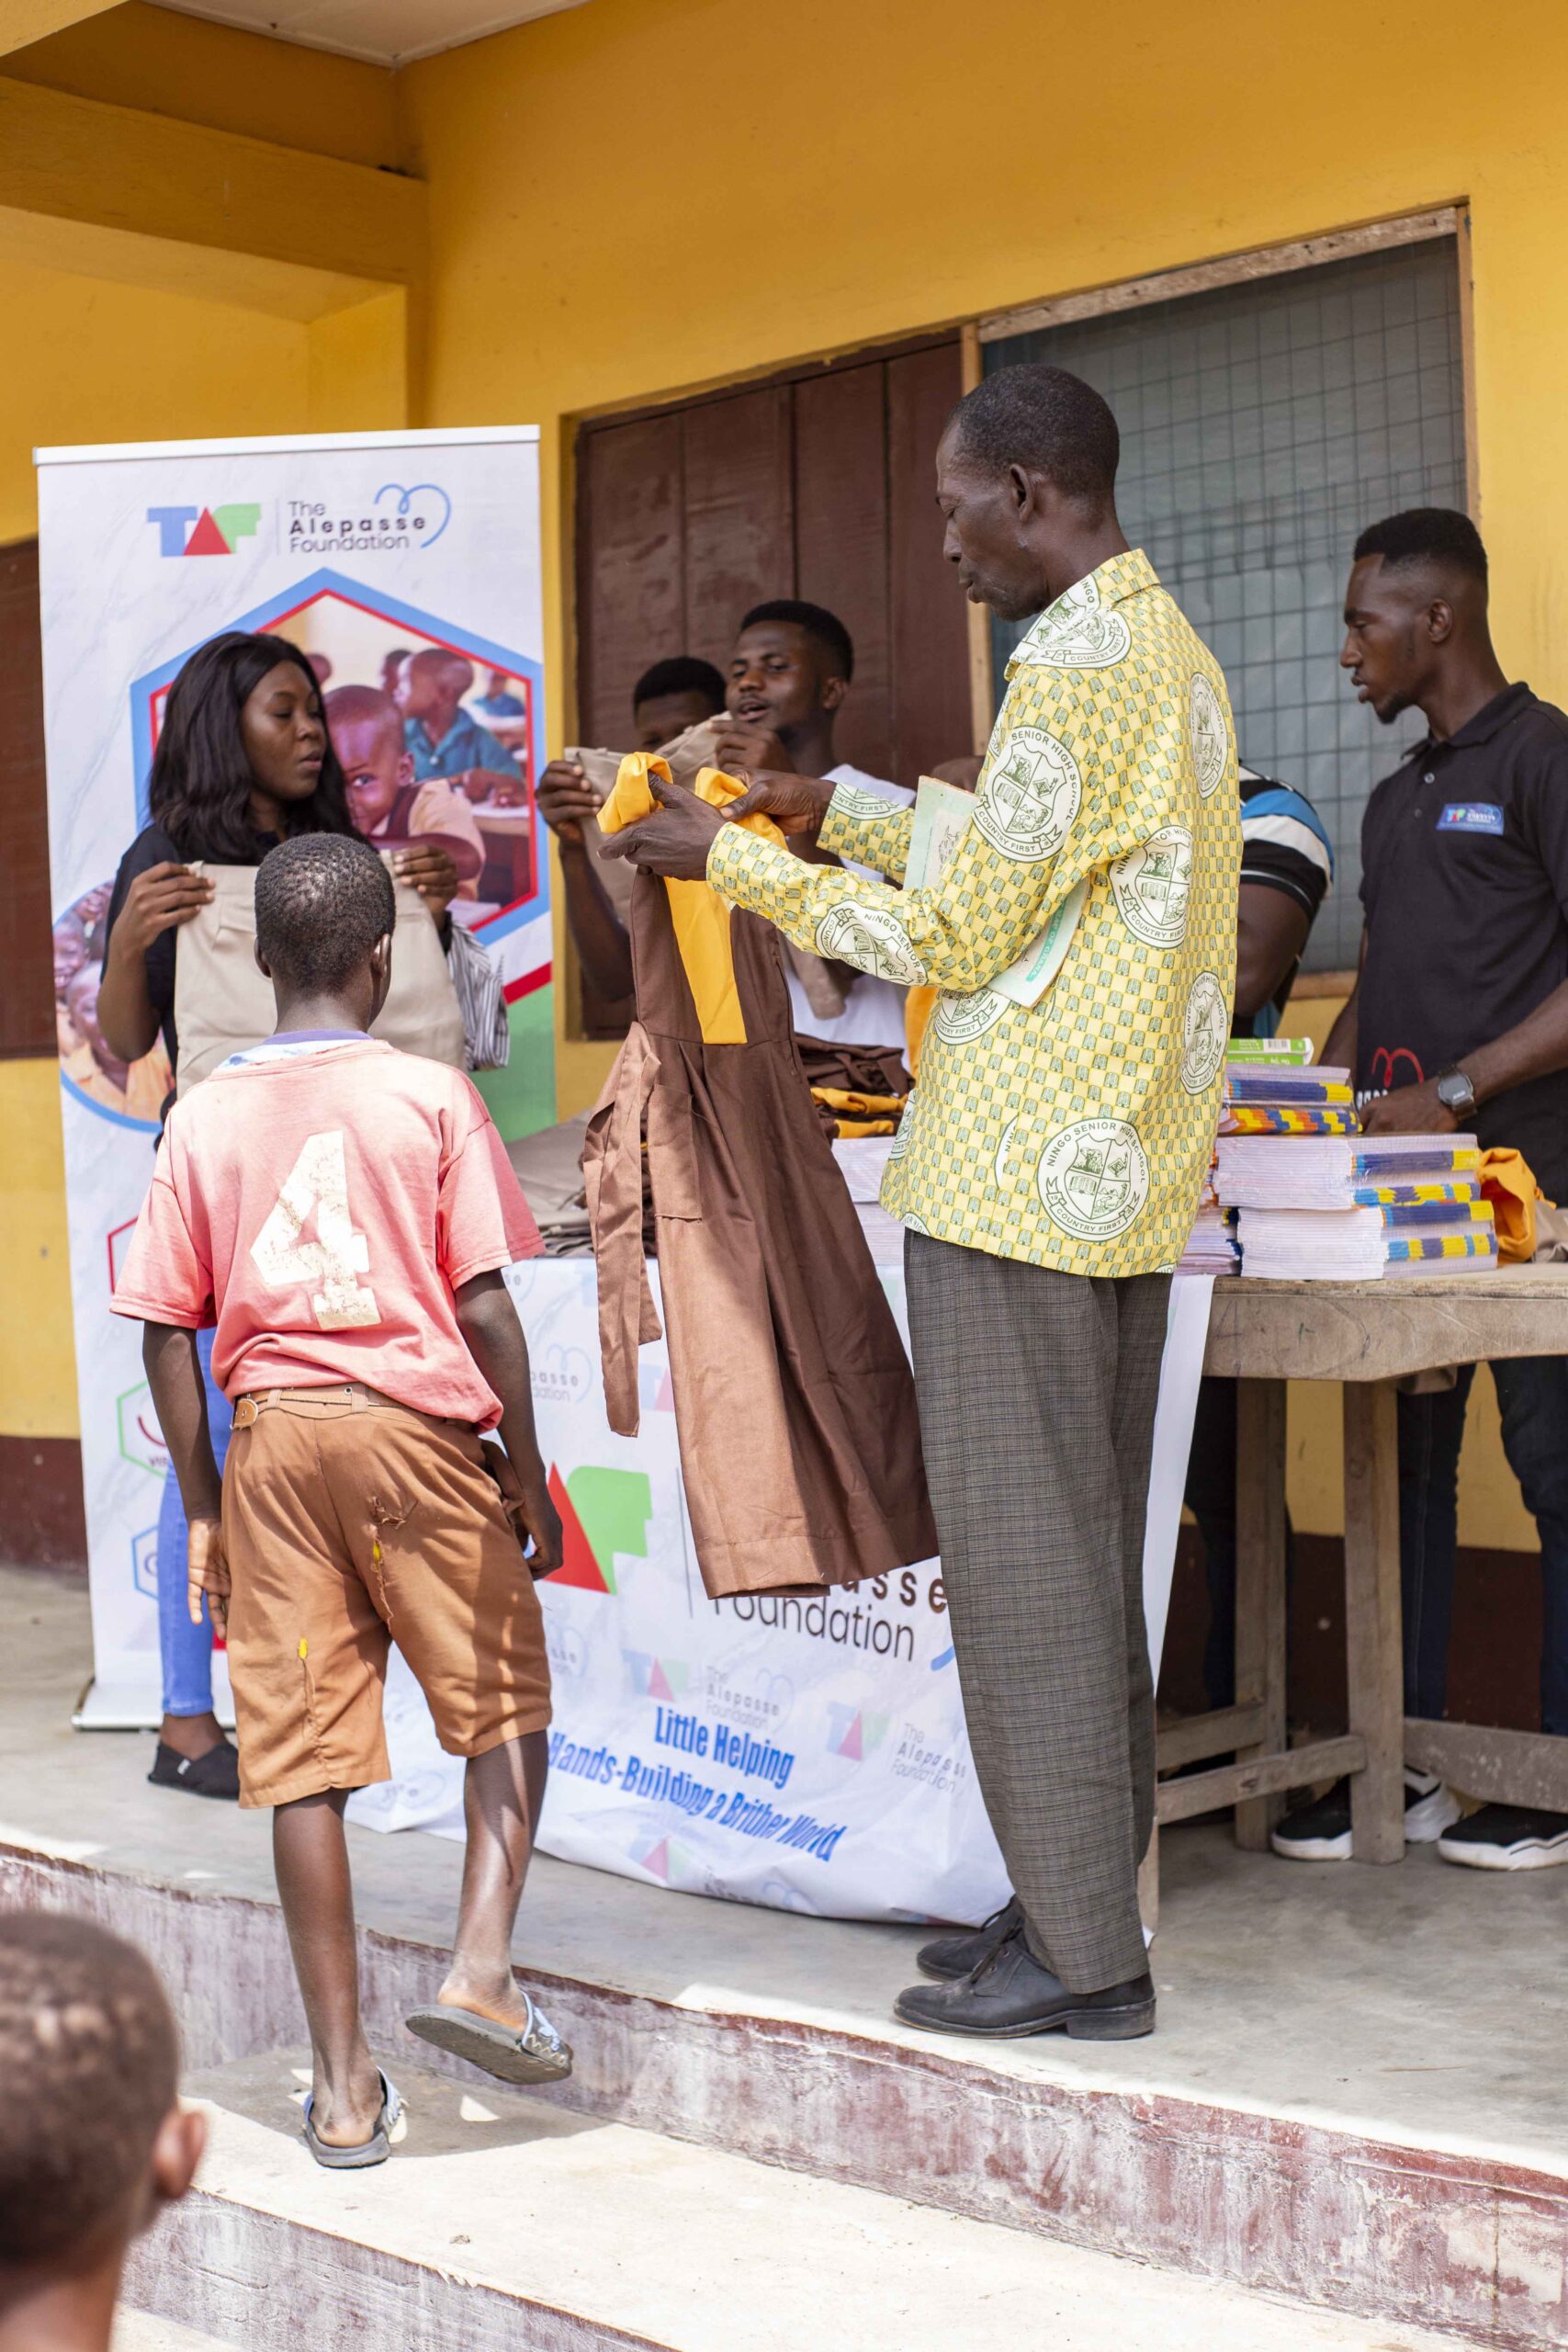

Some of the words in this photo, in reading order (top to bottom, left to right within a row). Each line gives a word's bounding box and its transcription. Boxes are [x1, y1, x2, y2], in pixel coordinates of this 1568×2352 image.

[288, 501, 326, 516] The
[289, 516, 425, 537] Alepasse
[289, 533, 411, 553] Foundation
[1079, 579, 1095, 604] INGO
[1011, 729, 1050, 745] SENIOR
[1051, 742, 1074, 771] HIGH
[1066, 774, 1077, 821] SCHOOL
[833, 794, 858, 809] UNTRY
[978, 810, 1010, 847] COUNTRY
[1011, 842, 1036, 853] FIRST
[864, 913, 897, 932] NINGO
[1131, 914, 1168, 939] COUNTRY
[1047, 1134, 1072, 1167] NINGO
[1074, 1122, 1117, 1136] SENIOR
[1119, 1125, 1134, 1143] HIGH
[1131, 1139, 1145, 1184] SCHOOL
[250, 1129, 381, 1331] 4
[1056, 1207, 1096, 1232] COUNTRY
[1099, 1220, 1122, 1232] FIRST
[542, 1461, 653, 1596] AF
[706, 1683, 780, 1717] Alepasse
[904, 1722, 925, 1744] The
[654, 1705, 709, 1758] Little
[713, 1723, 796, 1791] Helping
[705, 1792, 728, 1821] a
[776, 1813, 848, 1863] World
